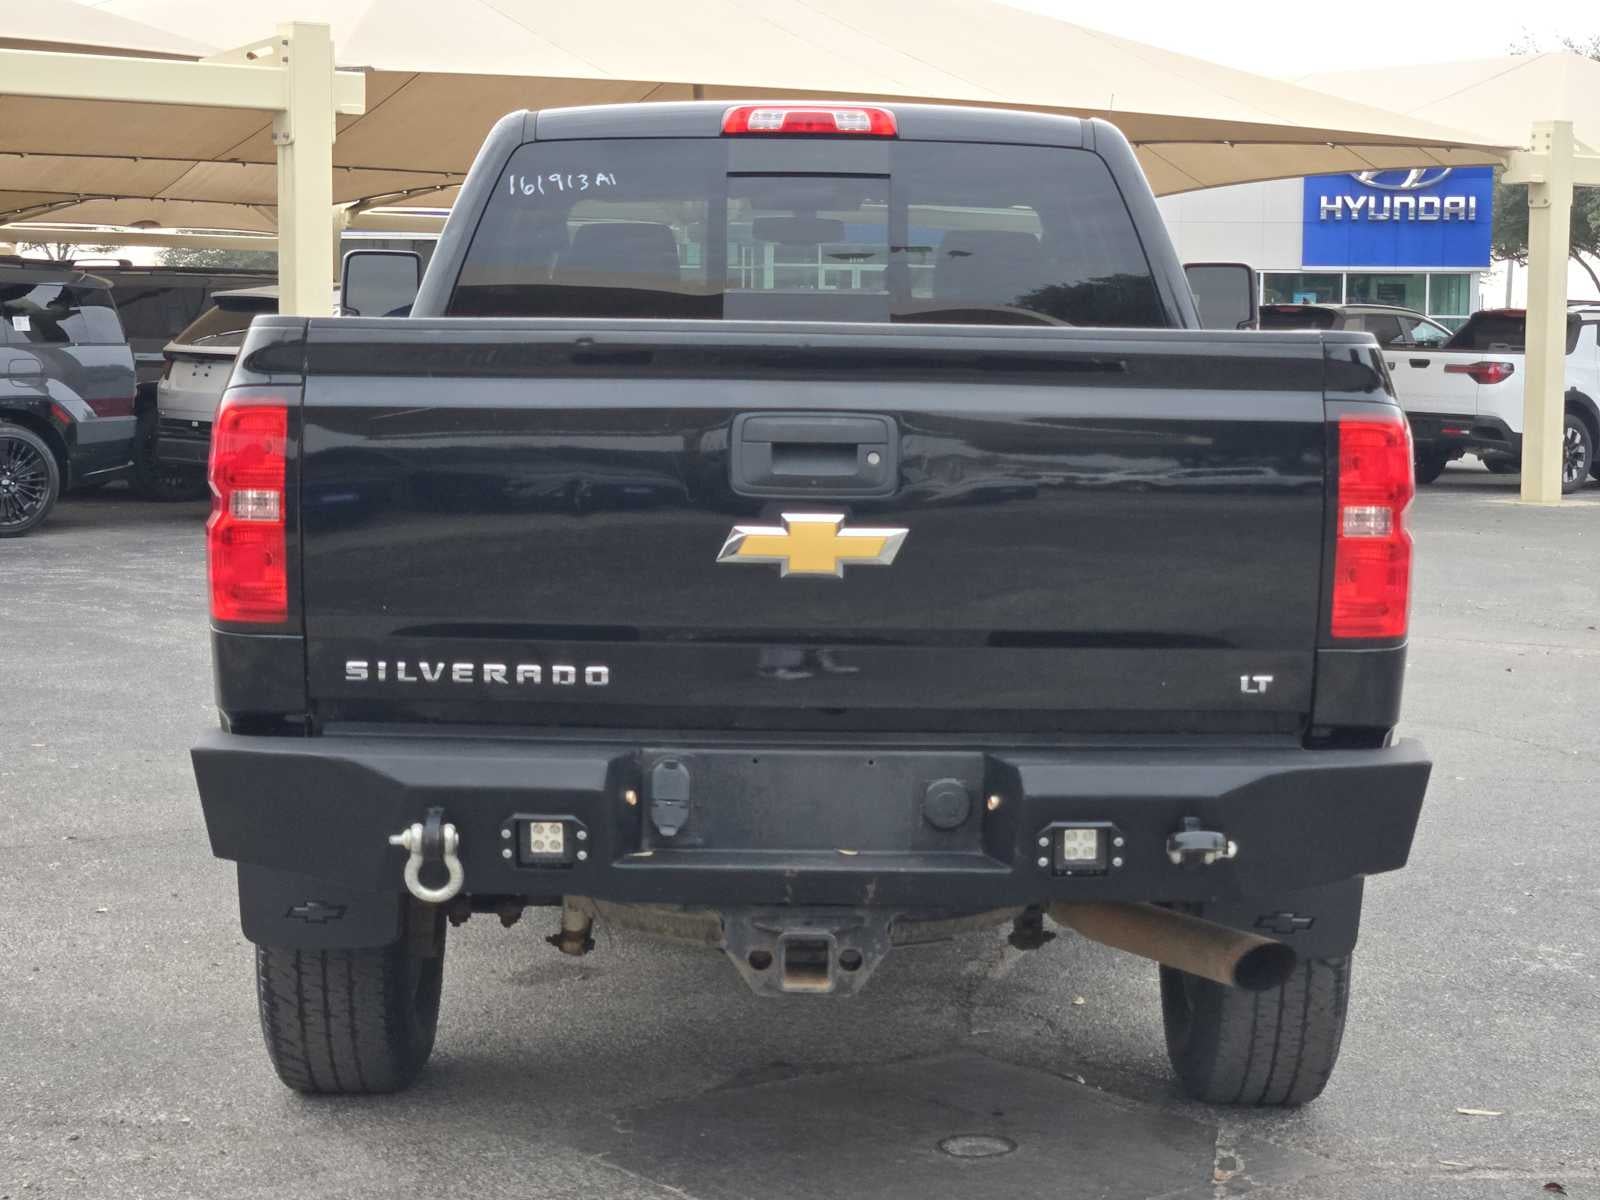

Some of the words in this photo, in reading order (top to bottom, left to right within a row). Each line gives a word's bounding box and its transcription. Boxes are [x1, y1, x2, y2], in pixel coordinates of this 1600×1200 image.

[1319, 195, 1477, 221] HYUNDAI
[345, 661, 609, 685] SILVERADO
[1240, 675, 1274, 693] LT
